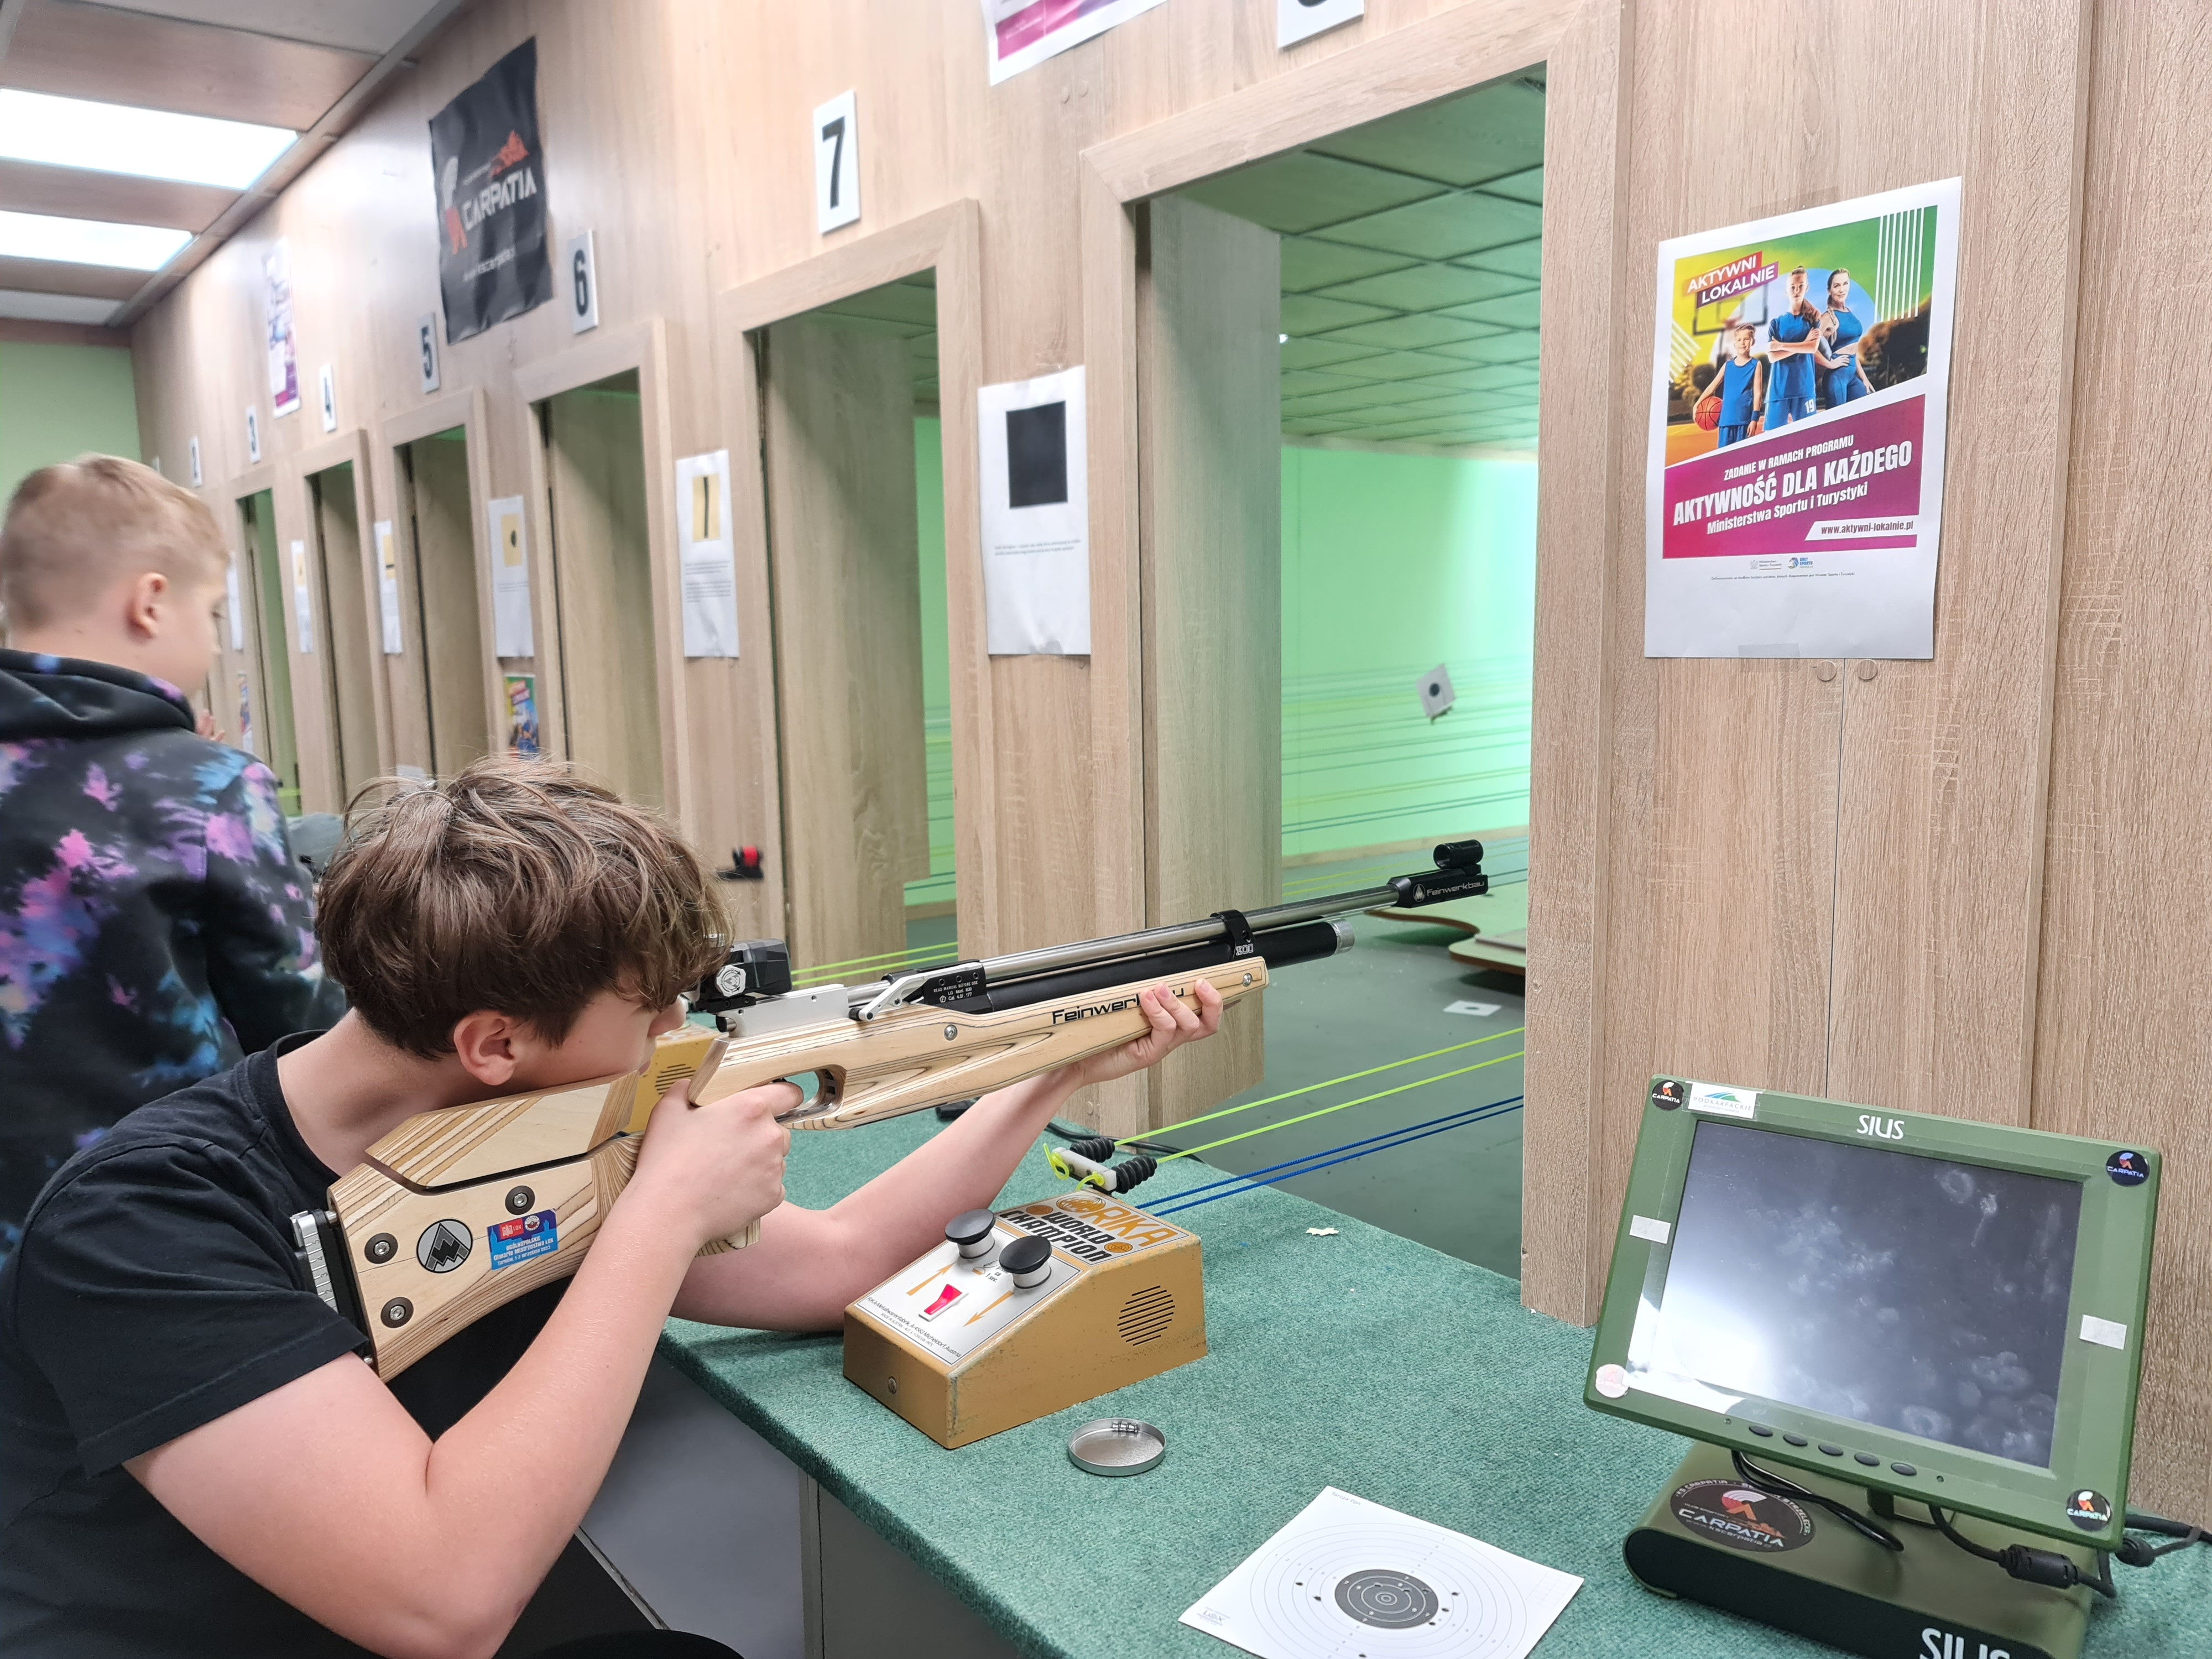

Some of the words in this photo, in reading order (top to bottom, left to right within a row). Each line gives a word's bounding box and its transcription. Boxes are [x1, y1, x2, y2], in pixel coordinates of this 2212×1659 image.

[822, 115, 847, 210] 7
[462, 167, 537, 231] CARPATIA
[572, 249, 588, 317] 6
[1687, 255, 1757, 293] AKTYWNI
[1702, 265, 1775, 304] LOKALNIE
[420, 325, 434, 380] 5
[1805, 398, 1815, 414] 19
[1724, 463, 1756, 481] ZADANIE
[1757, 460, 1767, 471] W
[1768, 451, 1803, 469] RAMACH
[1806, 434, 1854, 459] PROGRAMU
[1673, 471, 1777, 526] AKTYWNOŚĆ
[1782, 466, 1818, 499] DLA
[1824, 440, 1913, 487] KAŻDEGO
[1707, 509, 1771, 535] Ministerstwa
[1773, 499, 1808, 521] Sportu
[1810, 498, 1814, 509] i
[1817, 481, 1869, 508] Turystyki
[1821, 520, 1914, 534] www.aktywni-lokalnie.pl
[1427, 881, 1484, 896] Feinwerkbau
[1235, 943, 1254, 956] 800
[1052, 988, 1185, 1024] Feinweru
[1652, 1093, 1680, 1104] CARPATIA
[1693, 1097, 1751, 1111] PODKARPACKIE
[1856, 1114, 1905, 1140] SIUS
[2106, 1166, 2145, 1178] CARPATIA
[506, 1235, 541, 1251] OGÓLNOPOLSKIE
[999, 1210, 1113, 1262] CHAMPION
[1041, 1212, 1116, 1245] WORLD
[1079, 1206, 1179, 1248] RIKA
[514, 1240, 545, 1254] Mistrzostwa
[1332, 1491, 1349, 1501] Tarcza
[1684, 1480, 1728, 1489] CARPATIA
[1678, 1508, 1784, 1547] CARPATIA
[2067, 1508, 2108, 1521] CARPATIA
[1919, 1627, 2010, 1659] SI
